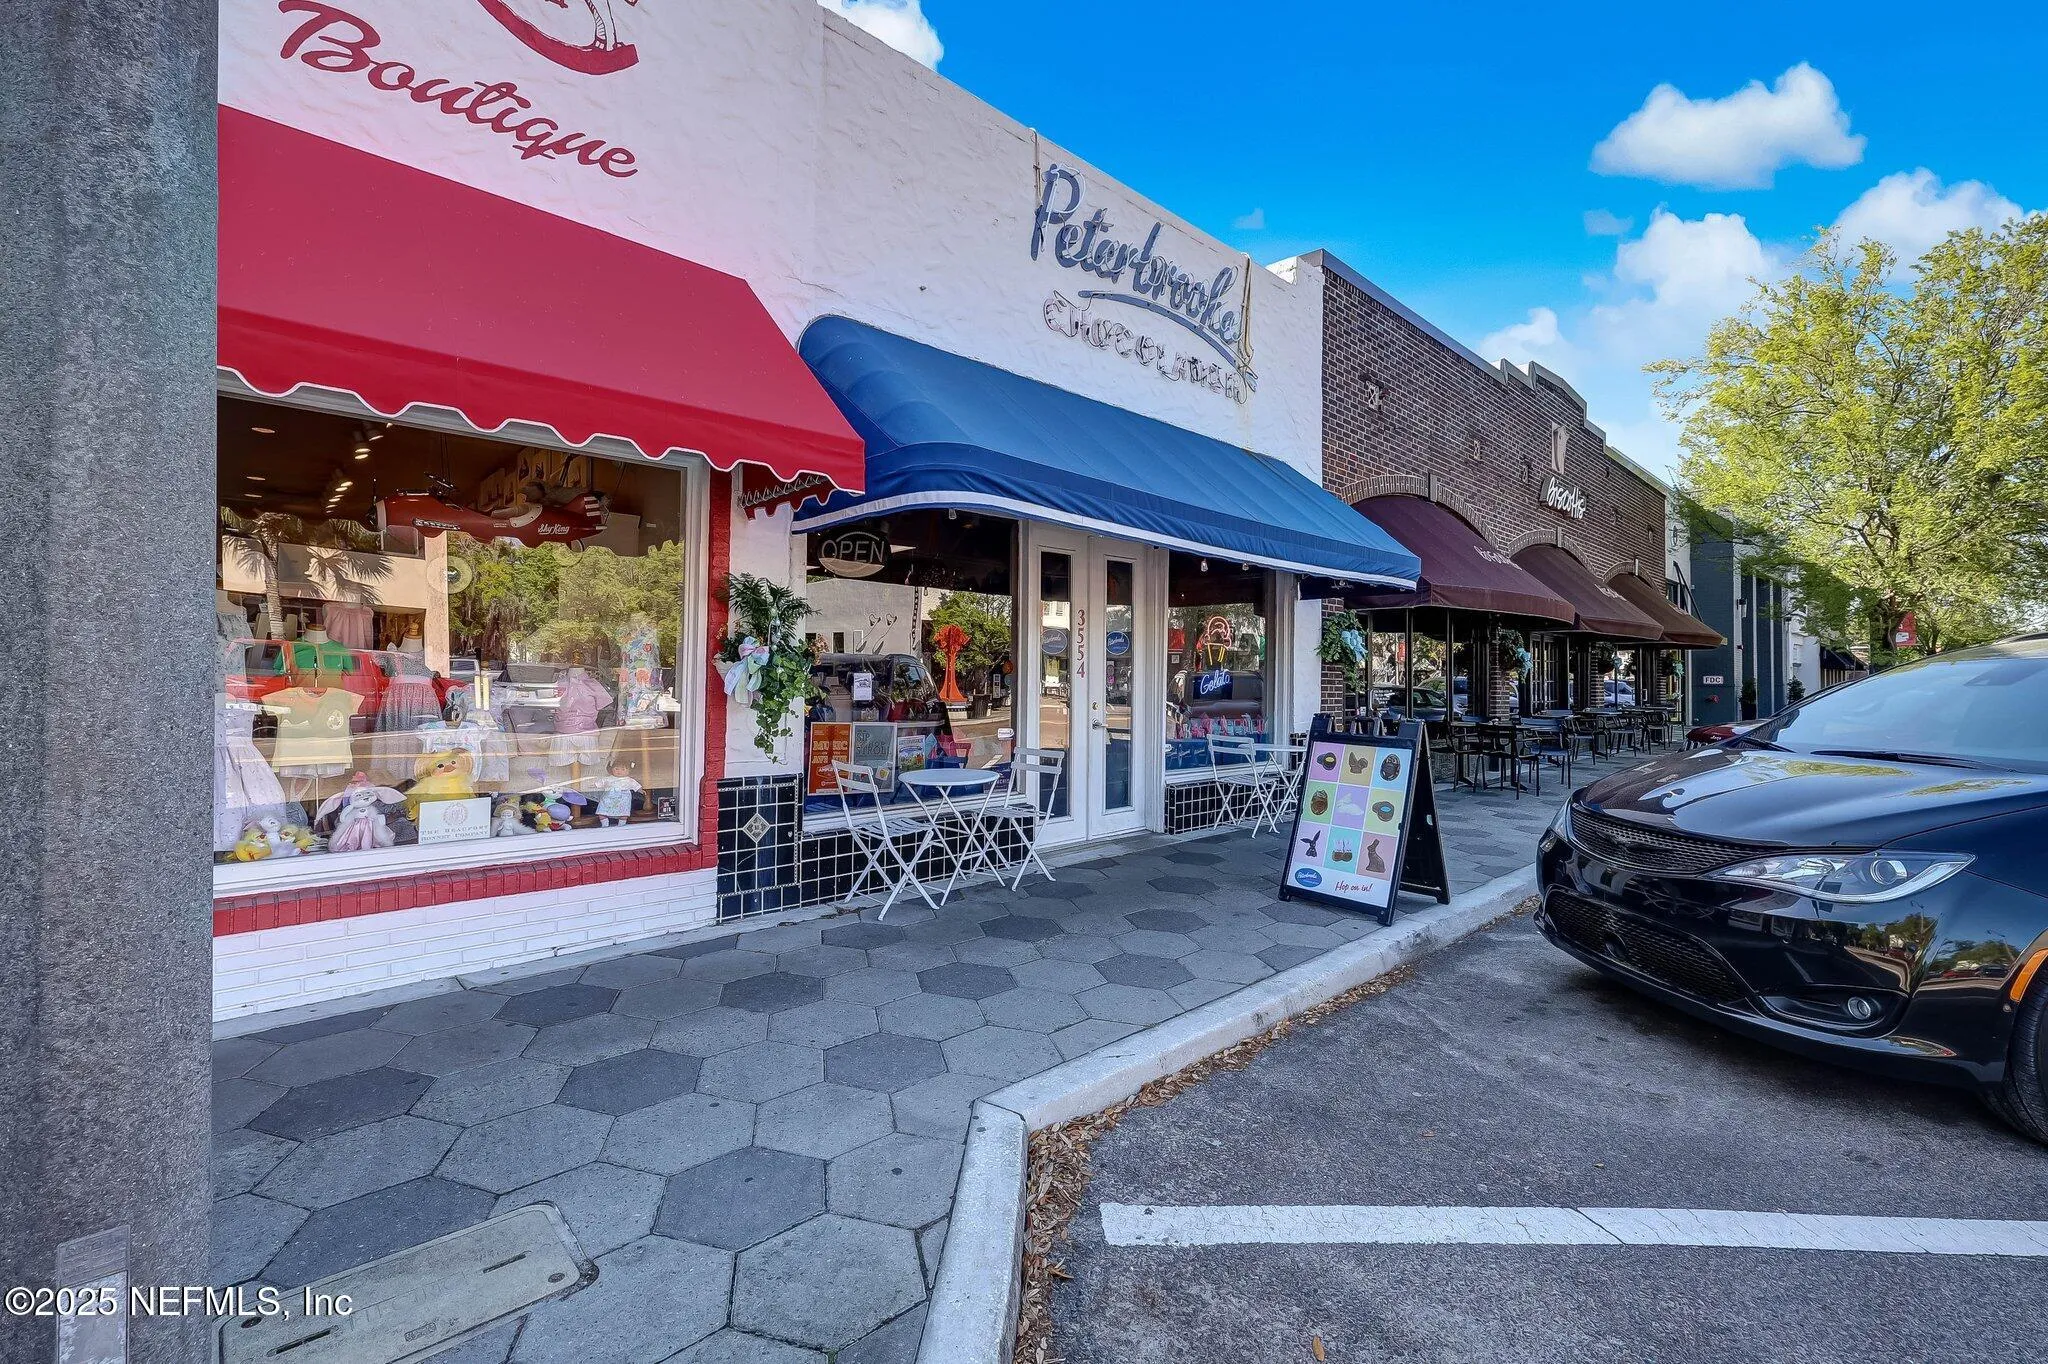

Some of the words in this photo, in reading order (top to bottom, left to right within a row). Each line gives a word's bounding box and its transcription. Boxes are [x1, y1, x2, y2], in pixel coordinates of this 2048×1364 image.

[278, 1, 639, 178] Boutique
[1030, 163, 1243, 344] Peterbrooke
[821, 540, 885, 563] OPEN
[1076, 608, 1086, 679] 3554
[1200, 669, 1230, 694] Gelato
[1705, 676, 1721, 684] FDC
[1335, 880, 1350, 893] Hop
[1361, 883, 1373, 892] in!
